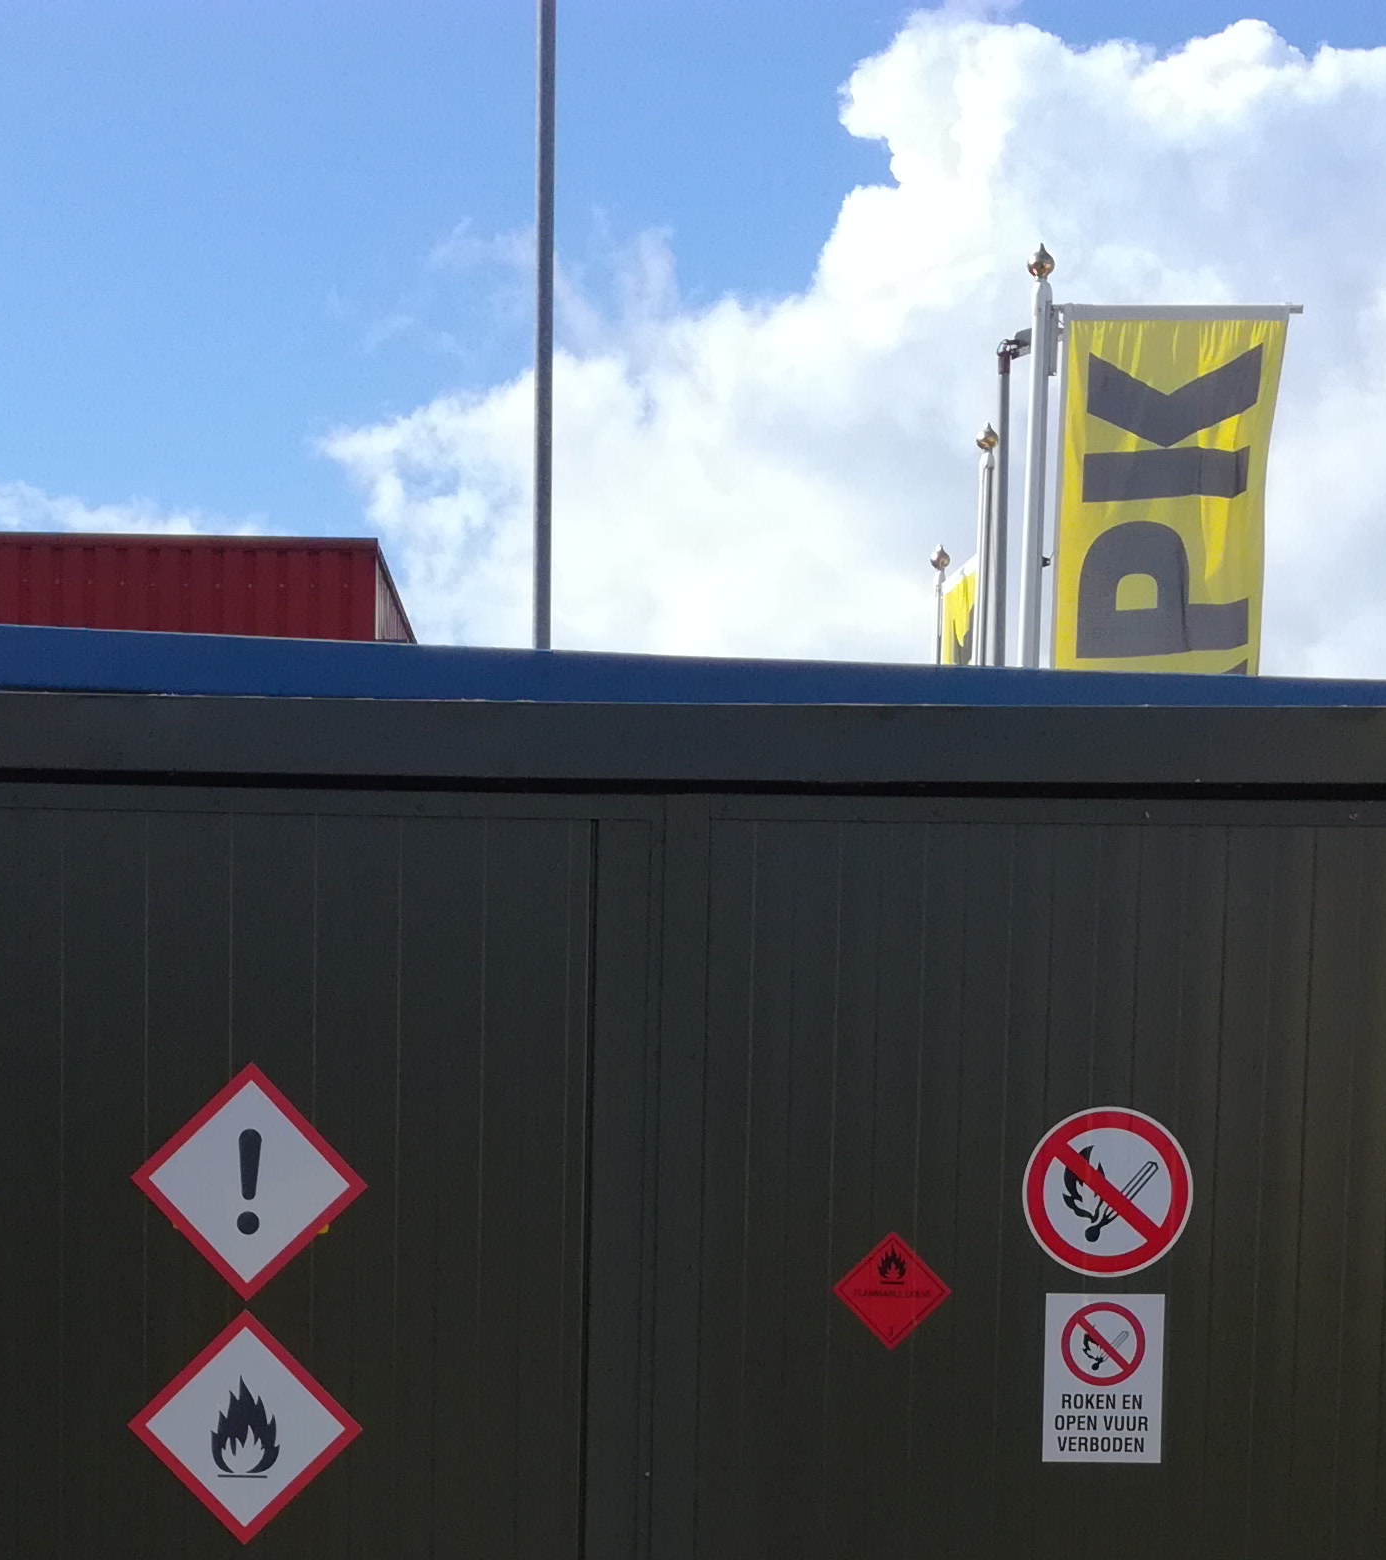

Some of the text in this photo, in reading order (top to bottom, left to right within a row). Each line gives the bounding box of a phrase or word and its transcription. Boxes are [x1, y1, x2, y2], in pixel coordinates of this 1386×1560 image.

[1076, 343, 1264, 675] PK
[1061, 1393, 1143, 1410] ROKEN EN
[1054, 1415, 1149, 1432] OPEN VUUR
[1057, 1436, 1145, 1453] VERBODEN
